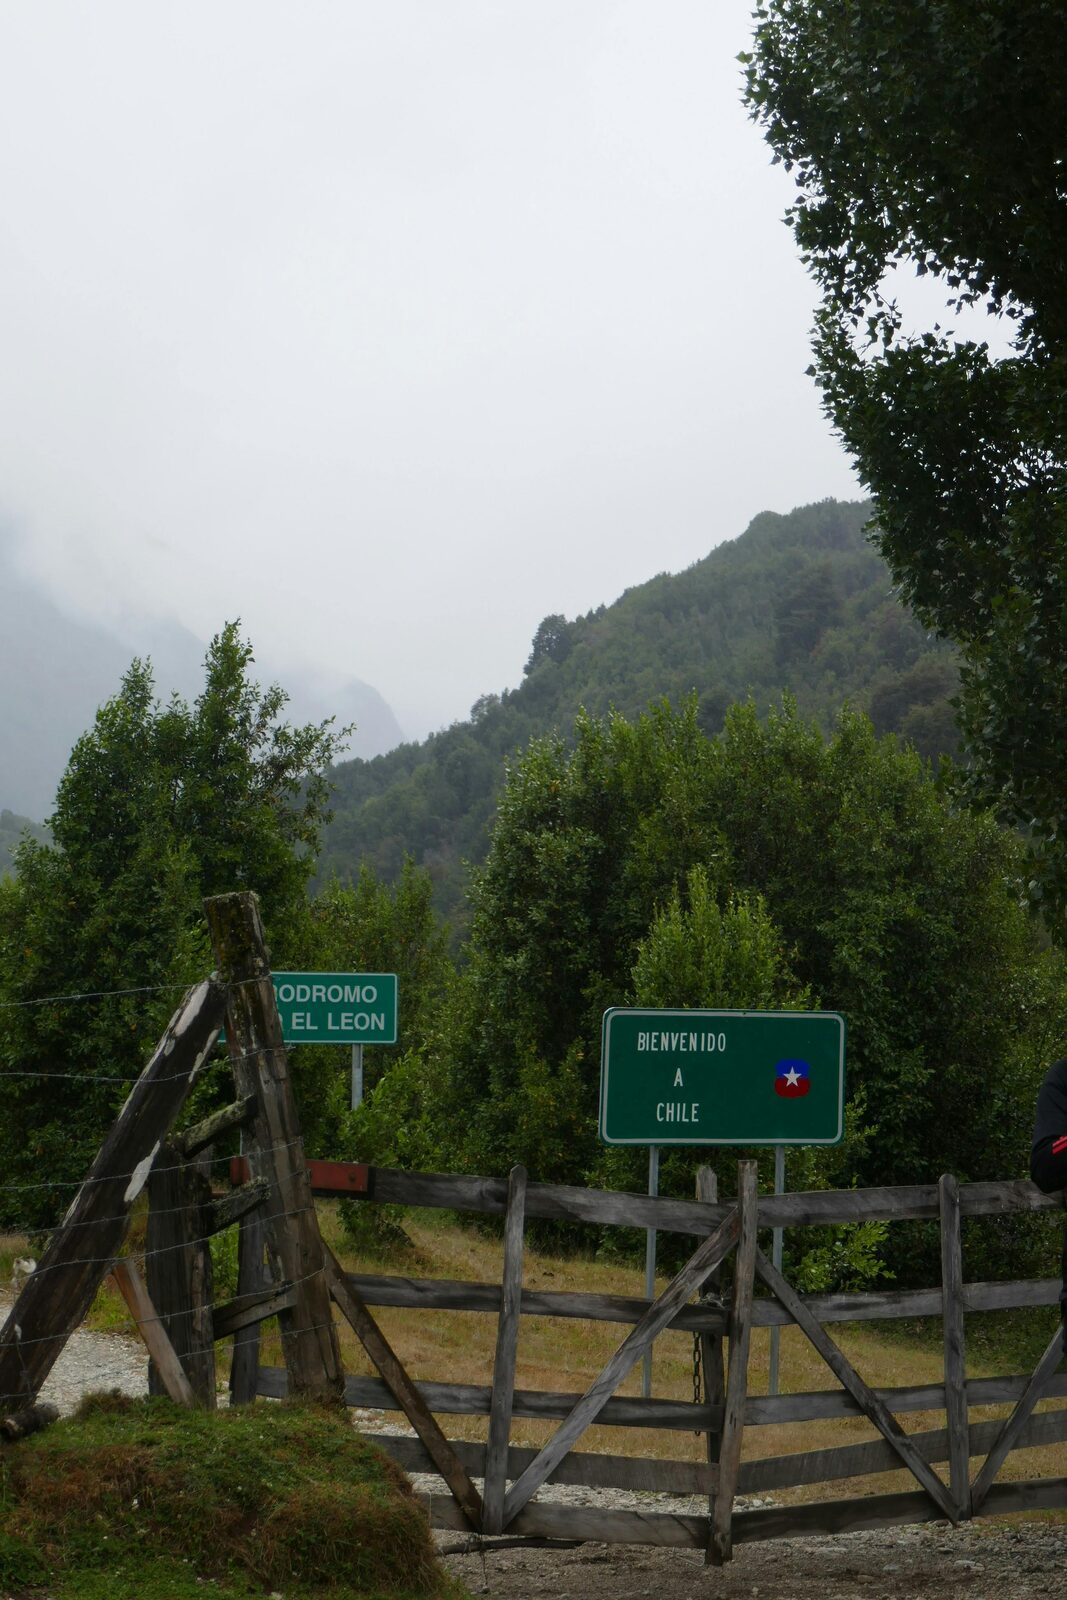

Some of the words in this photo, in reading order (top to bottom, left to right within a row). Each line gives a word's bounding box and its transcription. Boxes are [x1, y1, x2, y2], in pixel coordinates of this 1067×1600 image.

[273, 984, 377, 1003] ODROMO
[292, 1012, 318, 1030] EL
[328, 1012, 385, 1031] LEON
[637, 1032, 726, 1052] BIENVENIDO
[673, 1067, 683, 1087] A
[656, 1103, 699, 1122] CHILE
